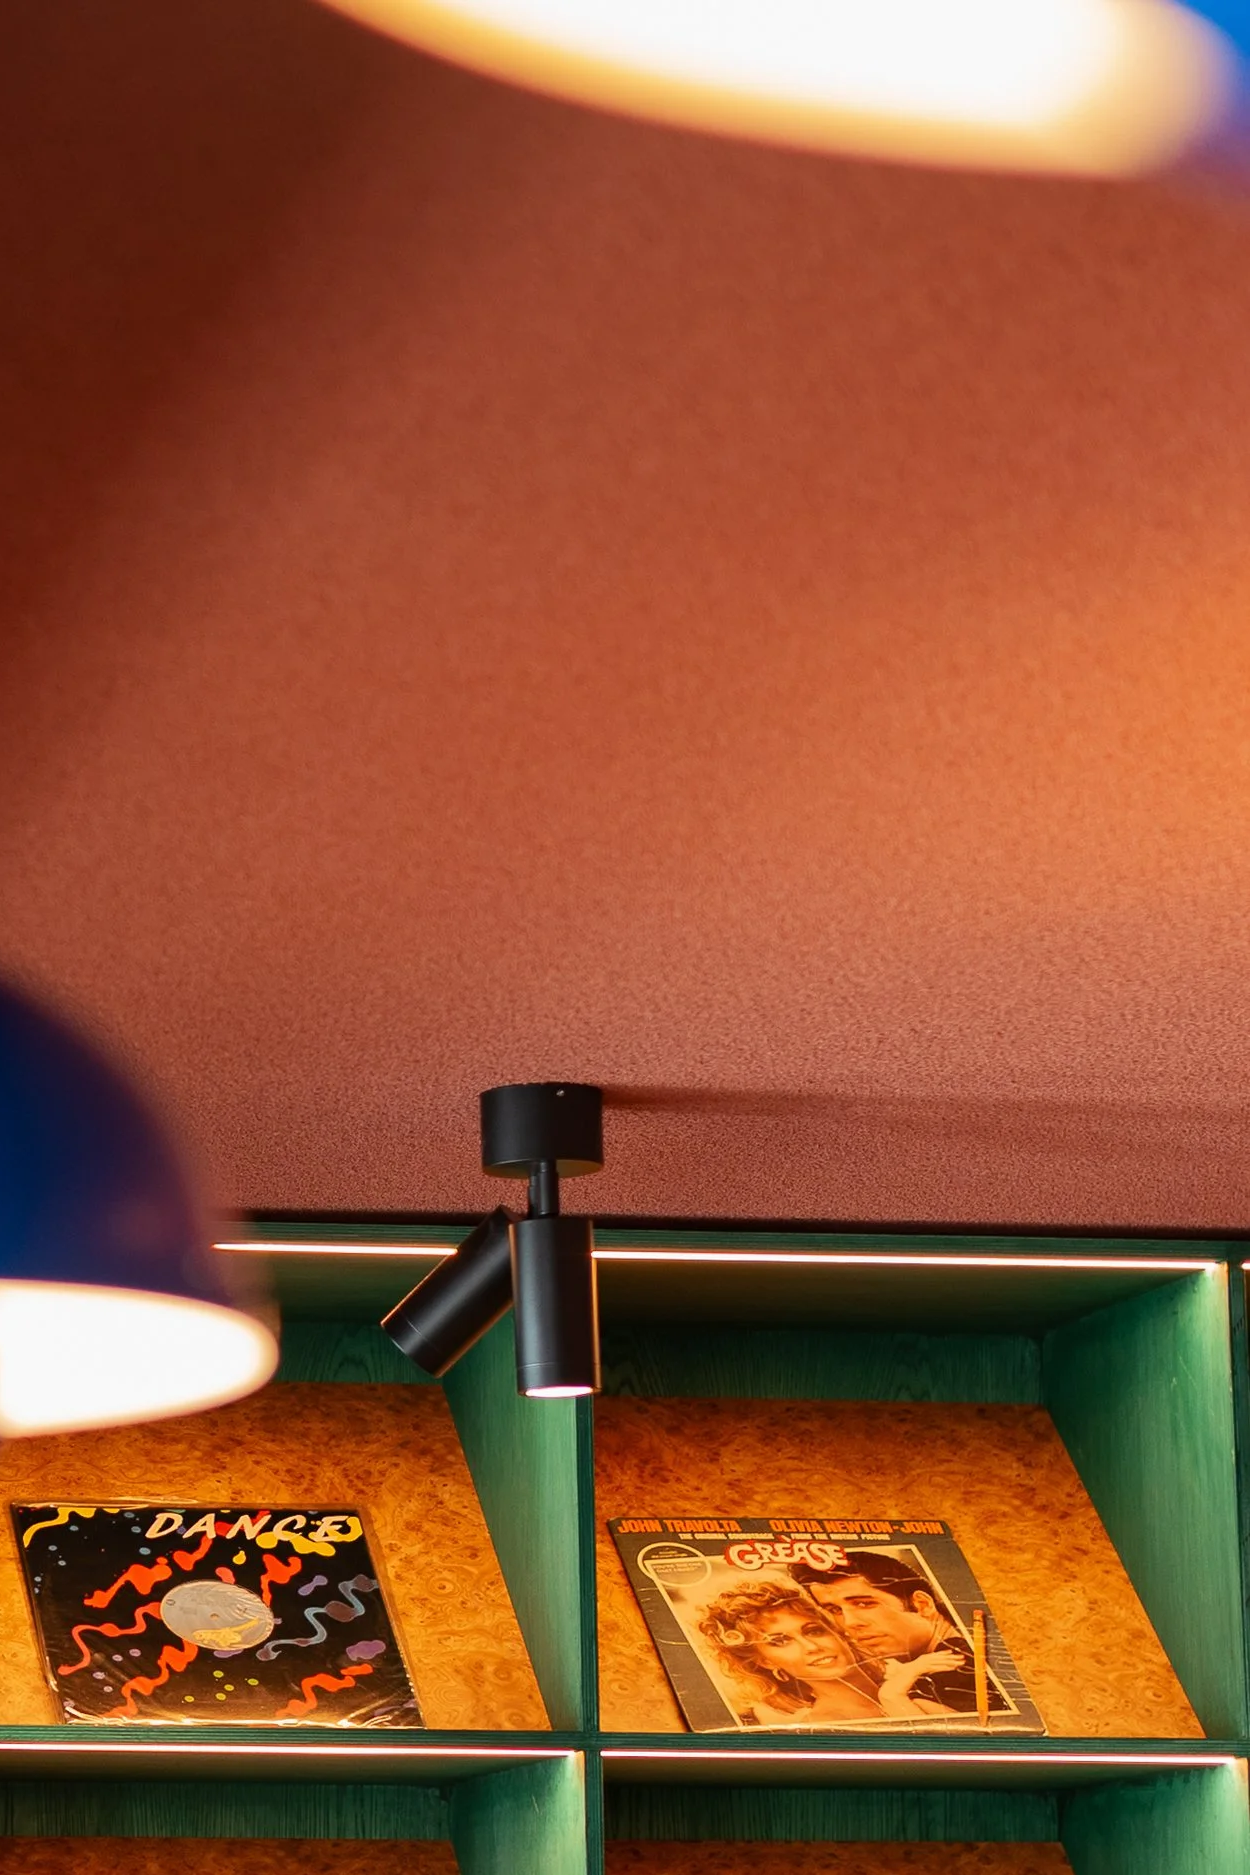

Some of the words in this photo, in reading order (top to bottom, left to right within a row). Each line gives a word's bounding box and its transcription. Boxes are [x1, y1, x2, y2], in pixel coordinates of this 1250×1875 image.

[145, 1512, 350, 1542] DANCE
[617, 1519, 662, 1533] JOHN
[663, 1519, 742, 1532] TRAVOLTA
[769, 1519, 824, 1533] OLIVIA
[823, 1520, 945, 1535] NEWTON-JOHN
[726, 1540, 849, 1571] GREASE
